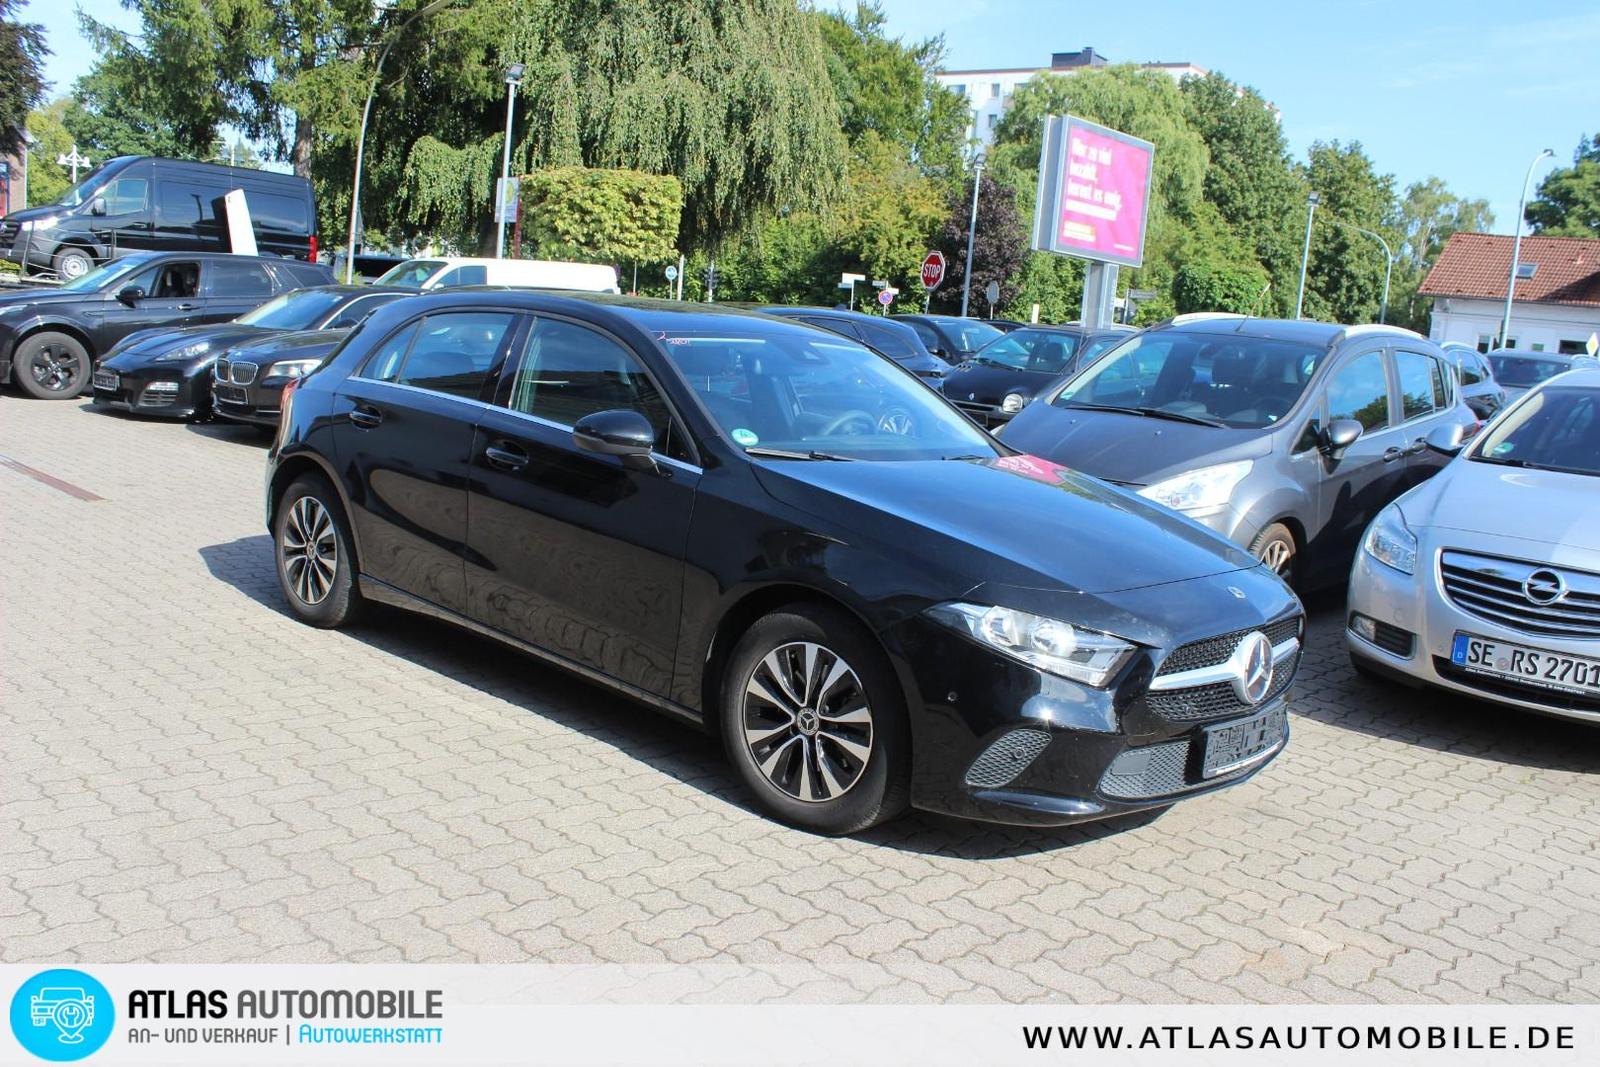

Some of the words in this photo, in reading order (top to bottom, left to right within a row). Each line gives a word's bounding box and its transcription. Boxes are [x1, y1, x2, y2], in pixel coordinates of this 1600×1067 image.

[923, 263, 941, 279] STOP
[1457, 651, 1463, 659] D
[1468, 641, 1495, 667] SE
[1510, 649, 1540, 676] RS
[1543, 656, 1600, 688] 2701
